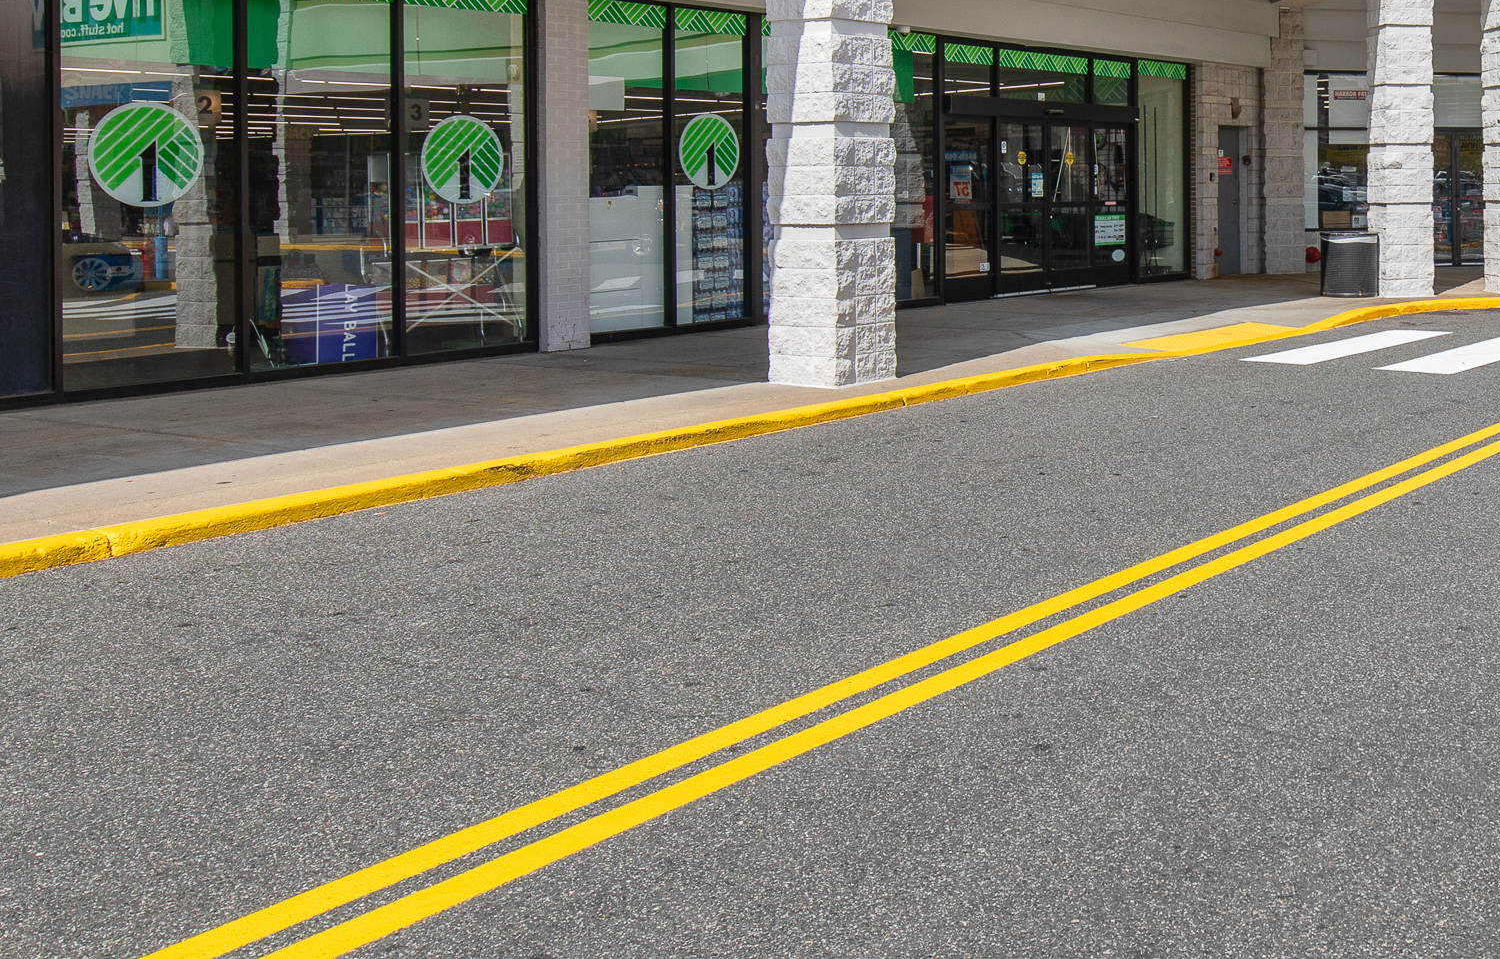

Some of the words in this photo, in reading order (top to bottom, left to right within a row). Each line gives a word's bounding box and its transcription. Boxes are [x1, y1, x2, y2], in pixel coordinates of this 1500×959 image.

[197, 96, 214, 115] 2
[410, 104, 423, 121] 3
[285, 127, 314, 139] NACK
[1460, 142, 1483, 150] AVING
[344, 284, 358, 312] LAY
[342, 320, 357, 362] BALL
